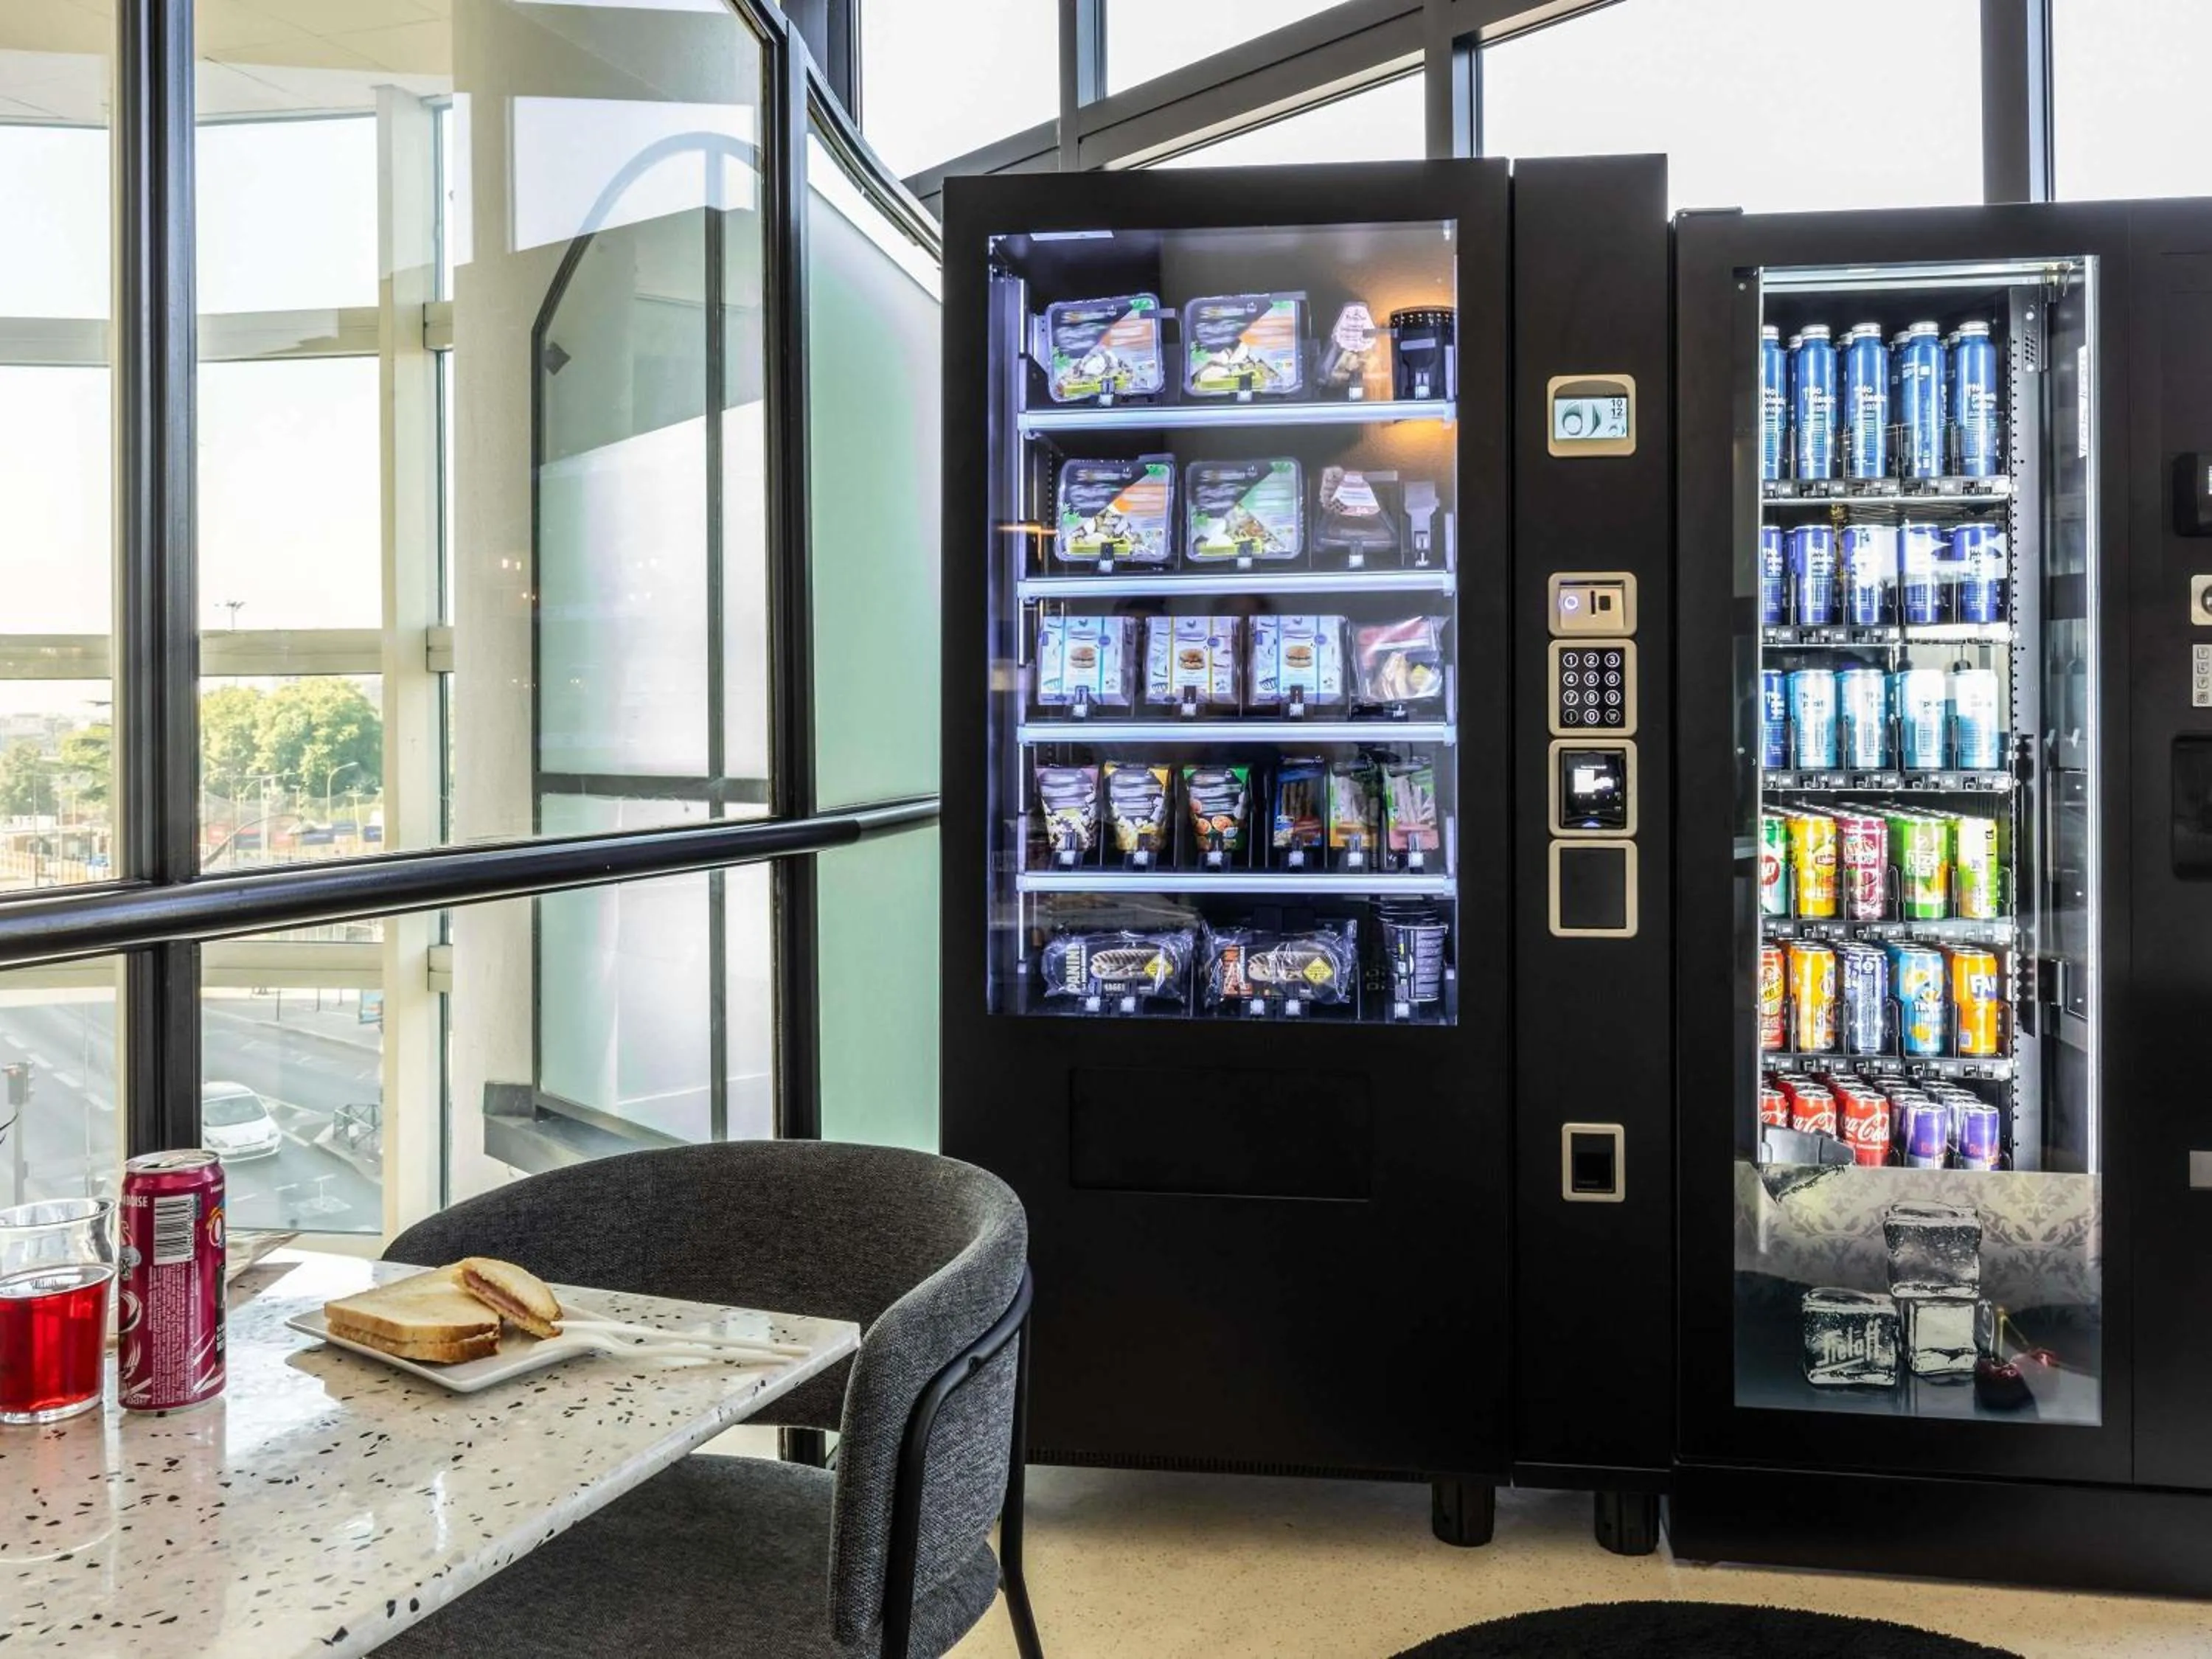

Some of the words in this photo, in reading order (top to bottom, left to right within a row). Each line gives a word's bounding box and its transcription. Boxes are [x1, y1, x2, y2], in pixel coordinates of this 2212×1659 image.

[1569, 656, 1573, 664] 1
[1588, 656, 1595, 664] 2
[1609, 655, 1615, 664] 3
[1567, 675, 1574, 683] 4
[1588, 675, 1595, 684] 5
[1609, 674, 1615, 684] 6
[1568, 694, 1574, 702] 7
[1588, 693, 1595, 703] 8
[1609, 693, 1615, 702] 9
[1589, 712, 1595, 720] 0
